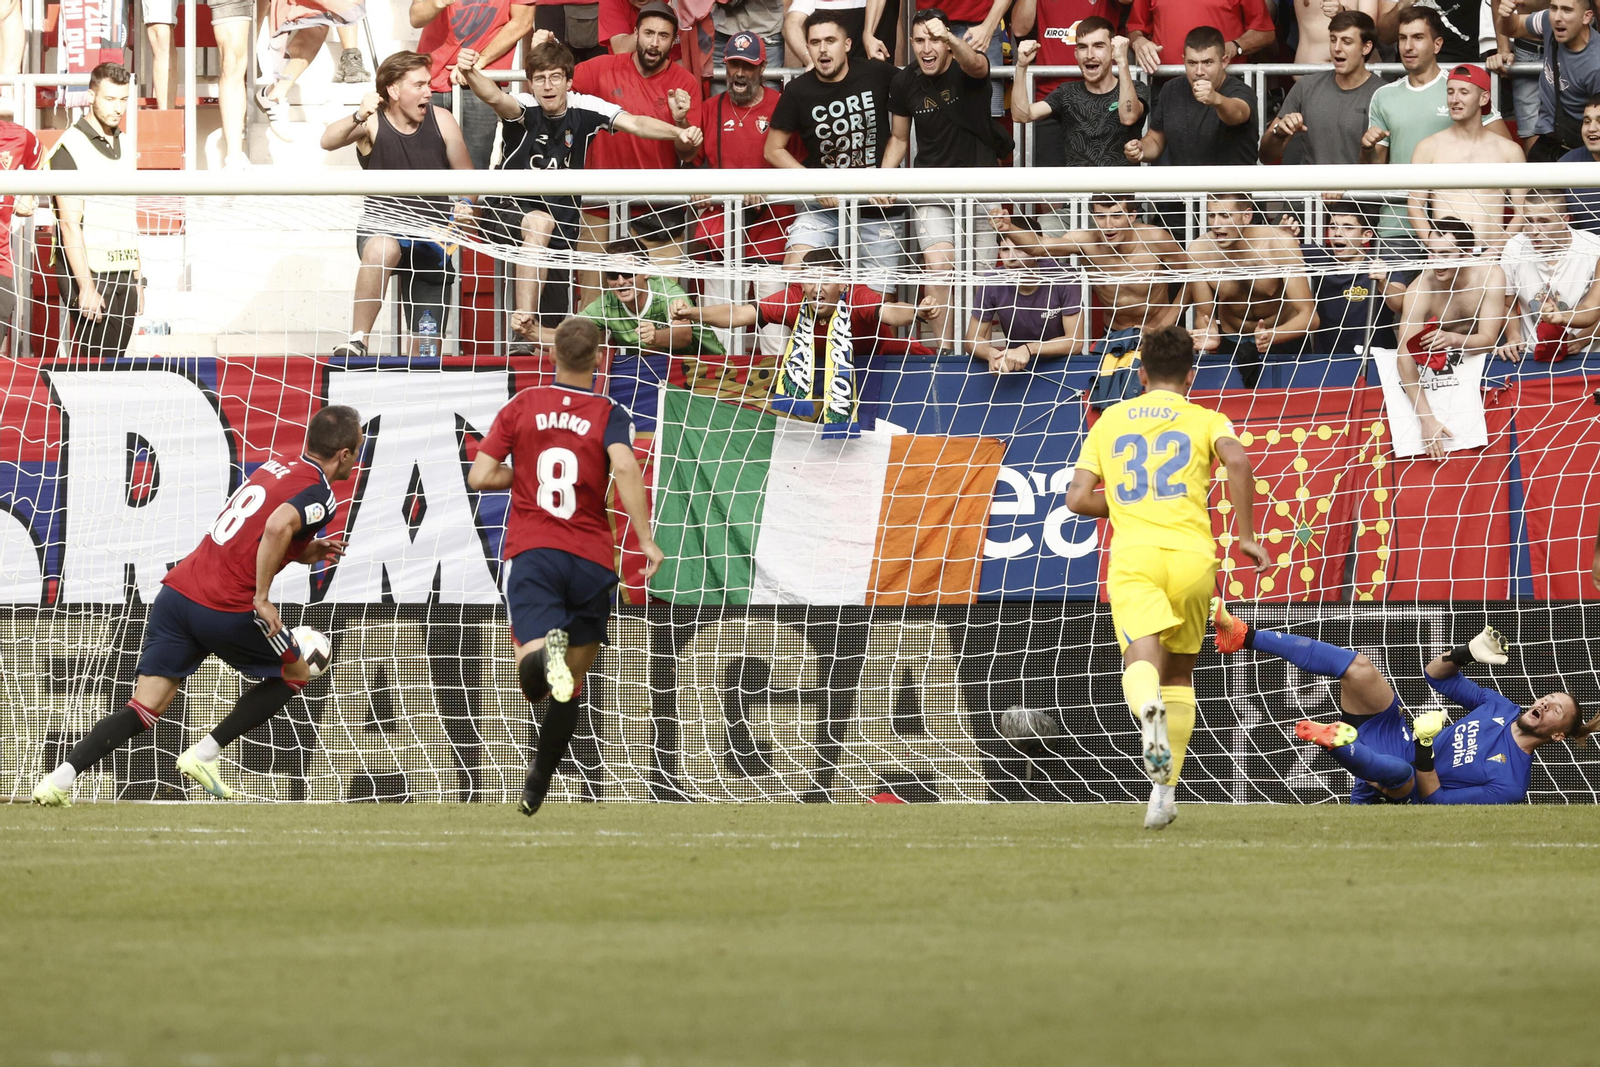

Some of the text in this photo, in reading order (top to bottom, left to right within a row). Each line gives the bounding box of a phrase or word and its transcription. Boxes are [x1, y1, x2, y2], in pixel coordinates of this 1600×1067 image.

[812, 91, 875, 123] CORE
[815, 109, 877, 140] CORE
[820, 128, 877, 155] CORE
[820, 146, 877, 169] CORE
[828, 299, 854, 416] NO PYRO
[535, 411, 591, 436] DARKO
[1127, 407, 1181, 421] CHUST
[536, 446, 579, 520] 8
[1111, 430, 1191, 505] 32
[1452, 724, 1467, 768] Capital
[1464, 719, 1480, 764] Khalifa
